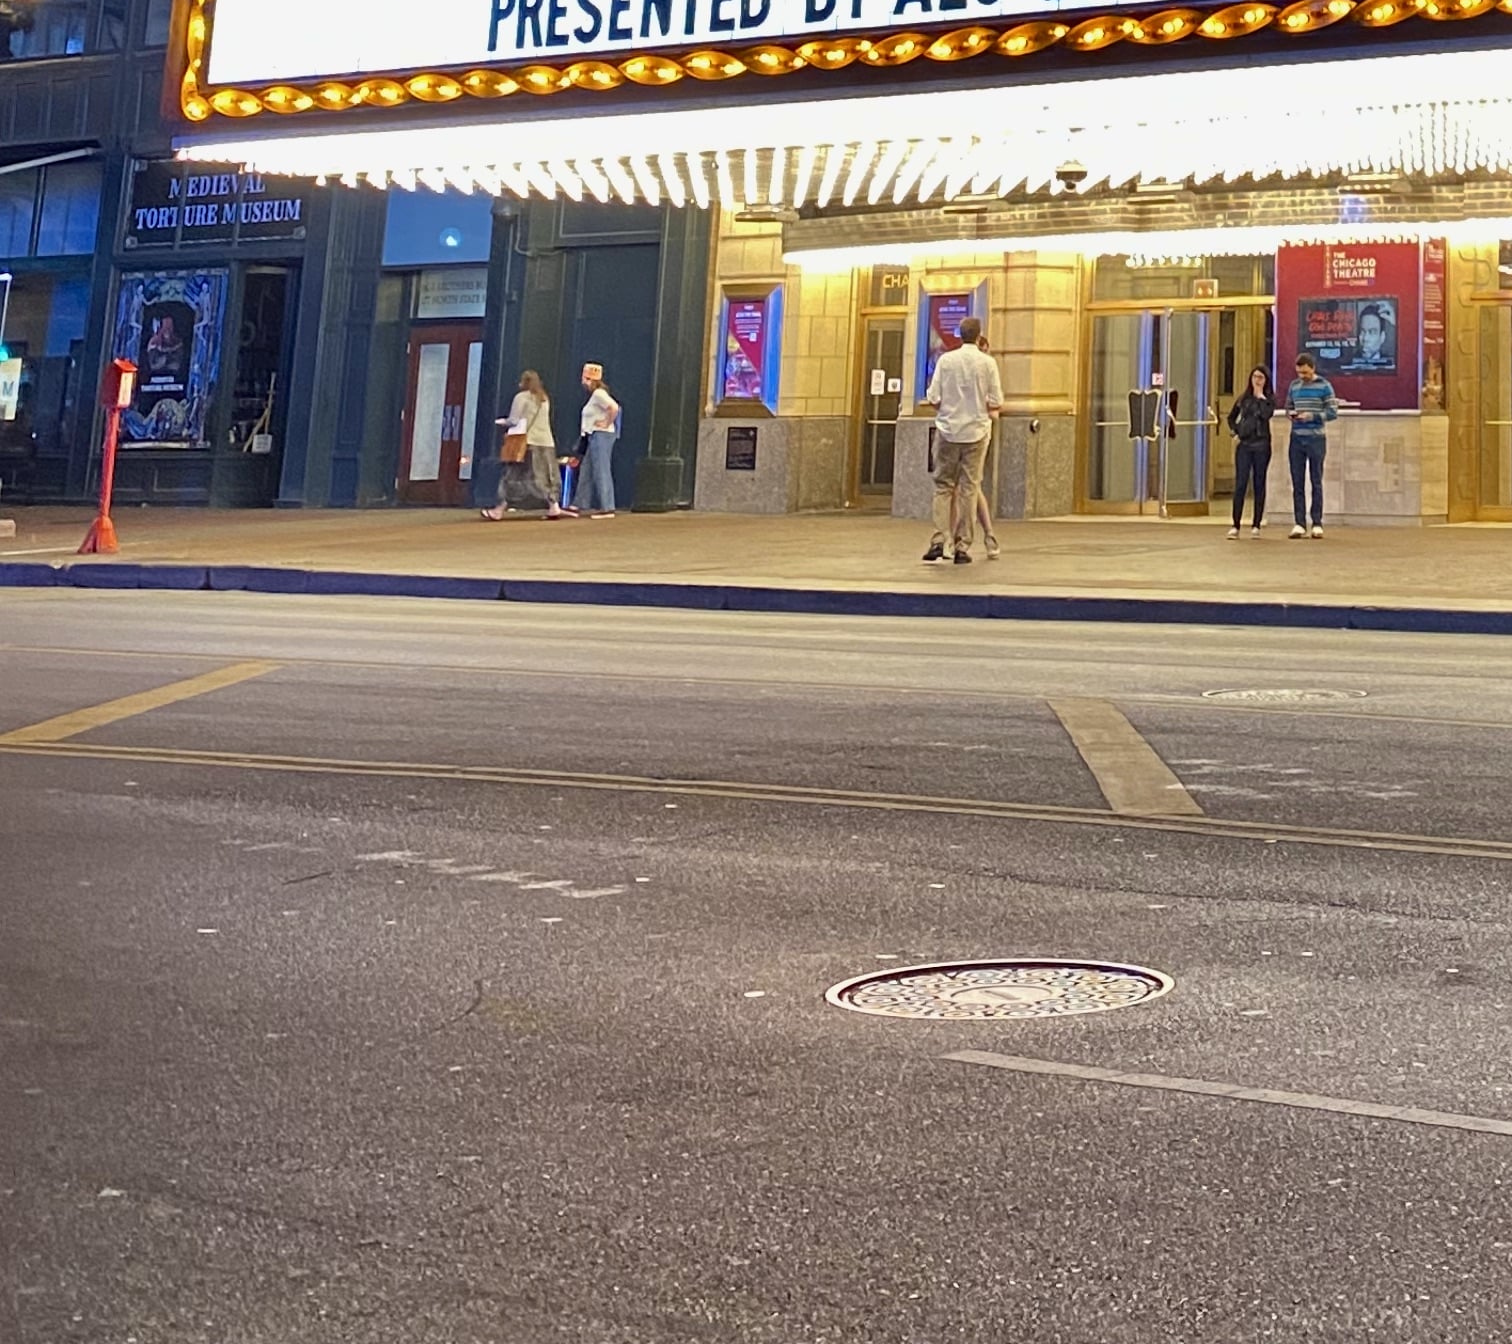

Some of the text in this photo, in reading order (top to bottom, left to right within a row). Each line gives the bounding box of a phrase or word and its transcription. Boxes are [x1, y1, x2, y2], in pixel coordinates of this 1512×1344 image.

[167, 173, 266, 199] MEDIEVAL
[135, 198, 302, 230] TORTURE MUSEUM
[1332, 258, 1377, 268] CHICAGO
[1333, 268, 1376, 279] THEATRE
